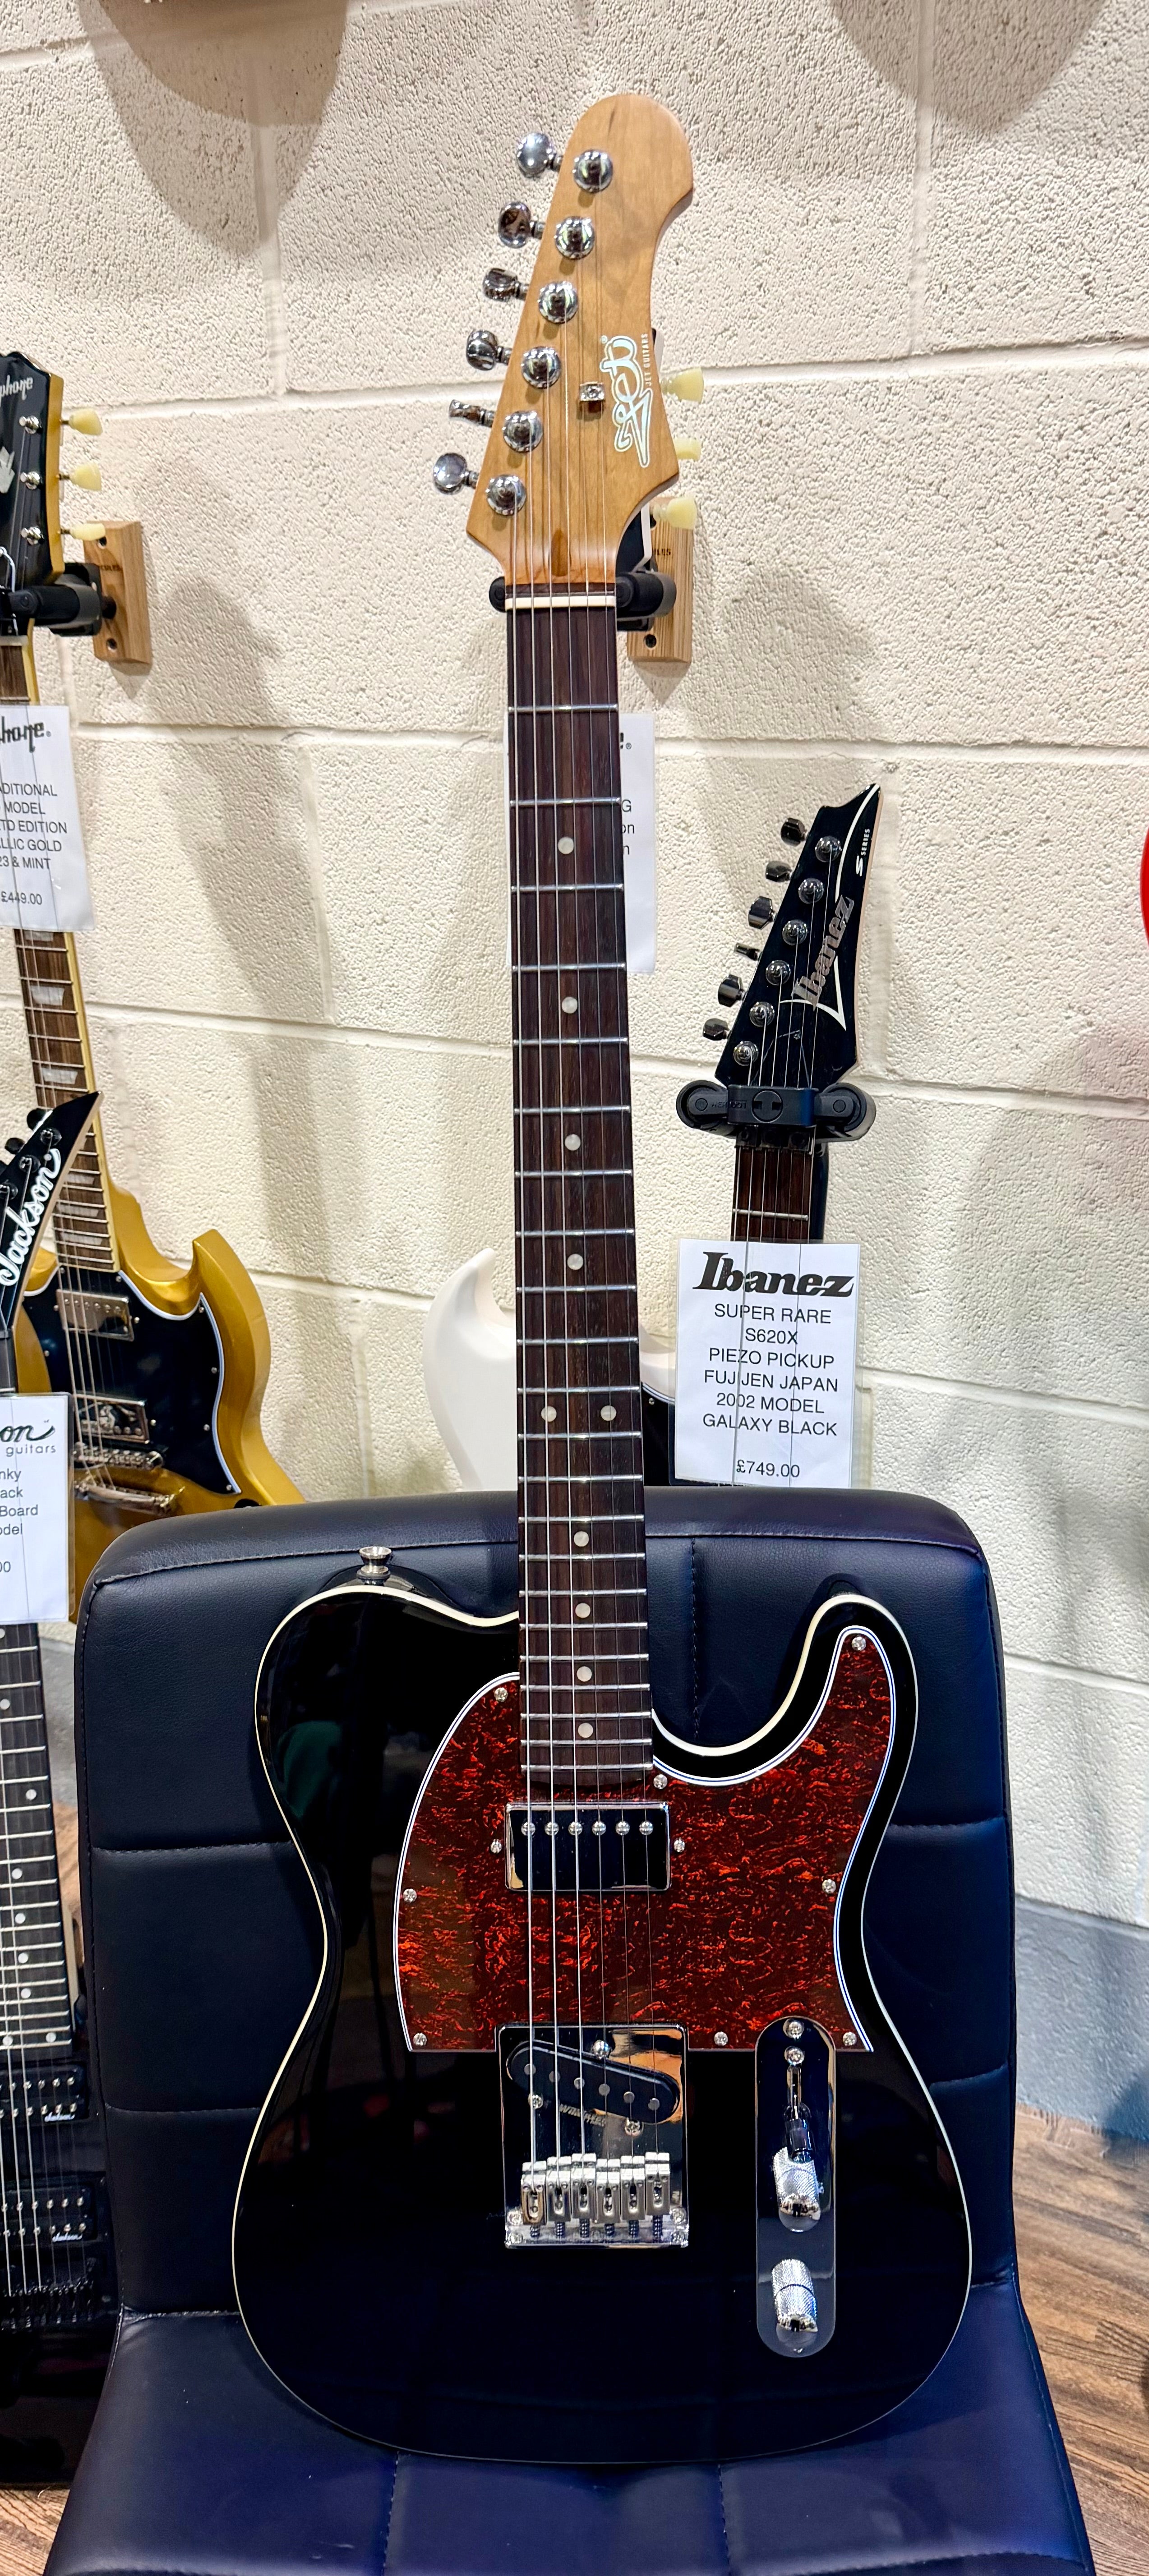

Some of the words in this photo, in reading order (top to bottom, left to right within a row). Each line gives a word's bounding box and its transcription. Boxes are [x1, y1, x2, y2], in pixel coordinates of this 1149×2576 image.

[4, 801, 46, 814] MODEL
[0, 819, 15, 831] TD
[18, 820, 67, 834] EDITION
[0, 837, 24, 850] LLIC
[27, 839, 62, 852] GOLD
[860, 828, 870, 856] SERIES
[22, 856, 51, 869] MINT
[1, 891, 42, 905] £449.00
[790, 894, 854, 1011] Ibanez
[0, 1148, 61, 1287] Jackson
[692, 1251, 854, 1297] Ibanez
[715, 1304, 774, 1321] SUPER
[781, 1309, 832, 1324] RARE
[745, 1328, 798, 1345] S620X
[709, 1348, 761, 1365] PIEZO
[767, 1352, 835, 1369] PICKUP
[780, 1376, 838, 1392] JAPAN
[716, 1393, 755, 1409] 2002
[761, 1397, 825, 1413] MODEL
[703, 1413, 773, 1432] GALAXY
[779, 1420, 838, 1436] BLACK
[6, 1444, 56, 1457] guitars
[736, 1460, 800, 1478] £749.00
[0, 1504, 38, 1517] Board
